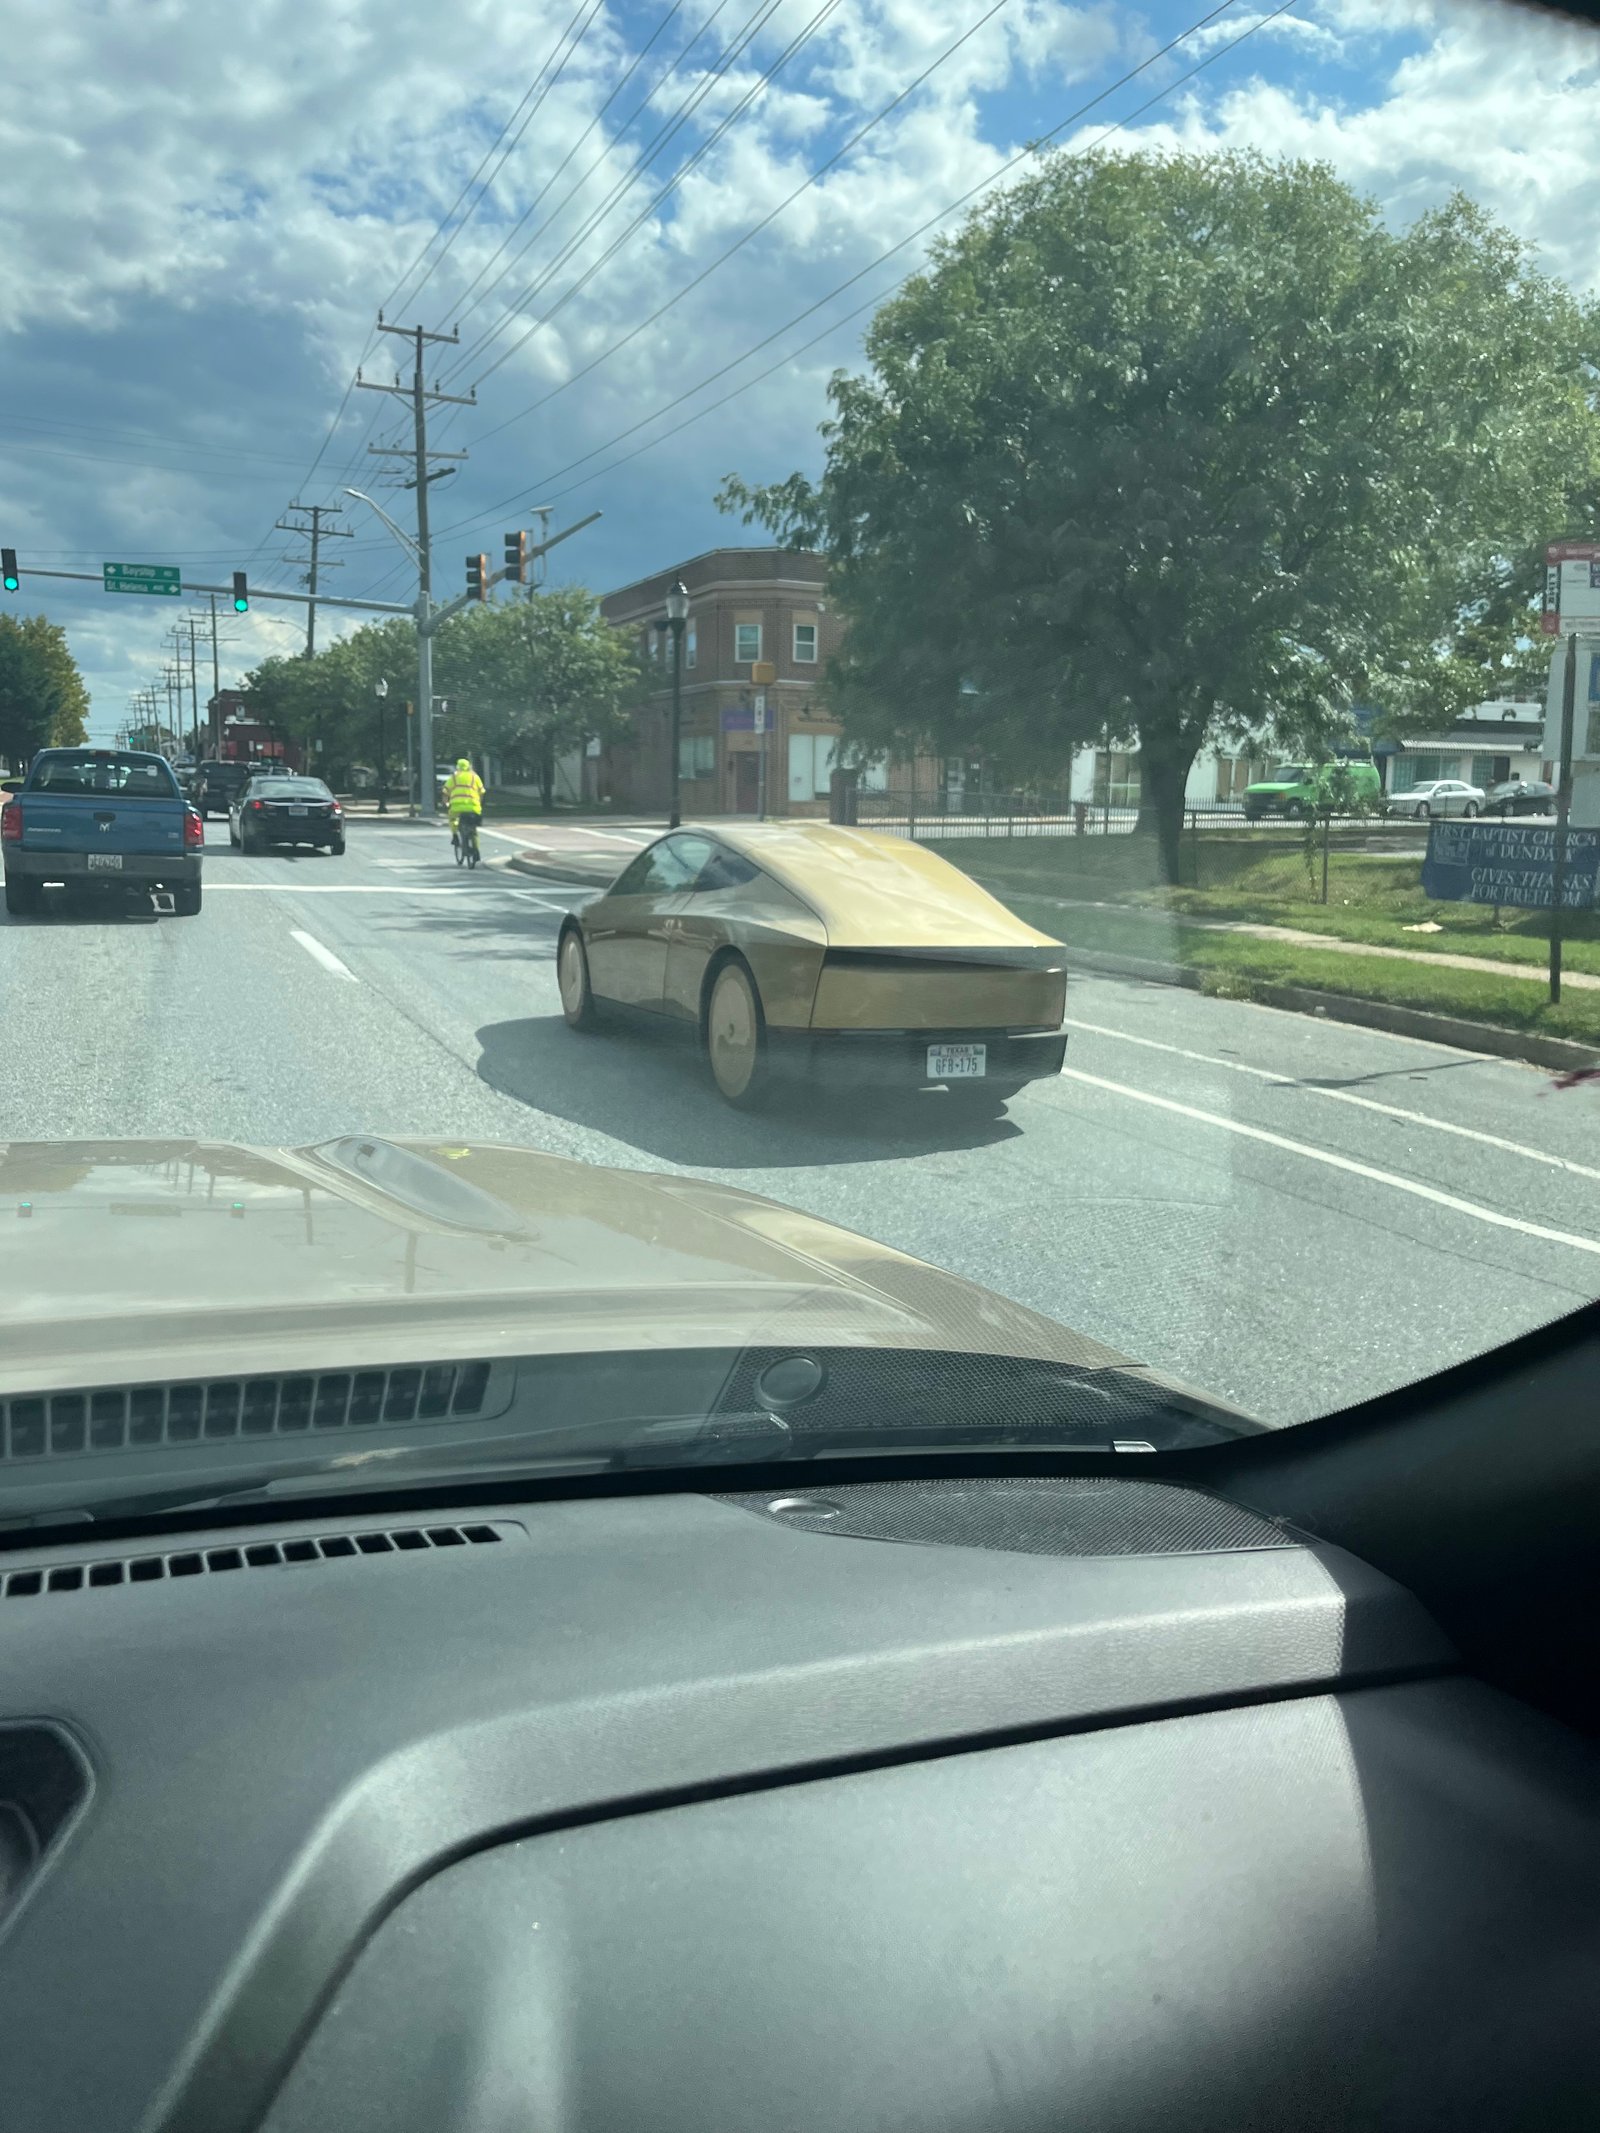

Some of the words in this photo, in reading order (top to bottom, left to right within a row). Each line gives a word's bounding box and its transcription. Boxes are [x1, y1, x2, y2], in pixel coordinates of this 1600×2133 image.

[1471, 826, 1530, 843] BAPTIST
[1532, 831, 1597, 847] CHRCH
[1500, 844, 1576, 862] DUNDAK
[1471, 866, 1515, 884] GIVES
[1471, 882, 1499, 899] FOR
